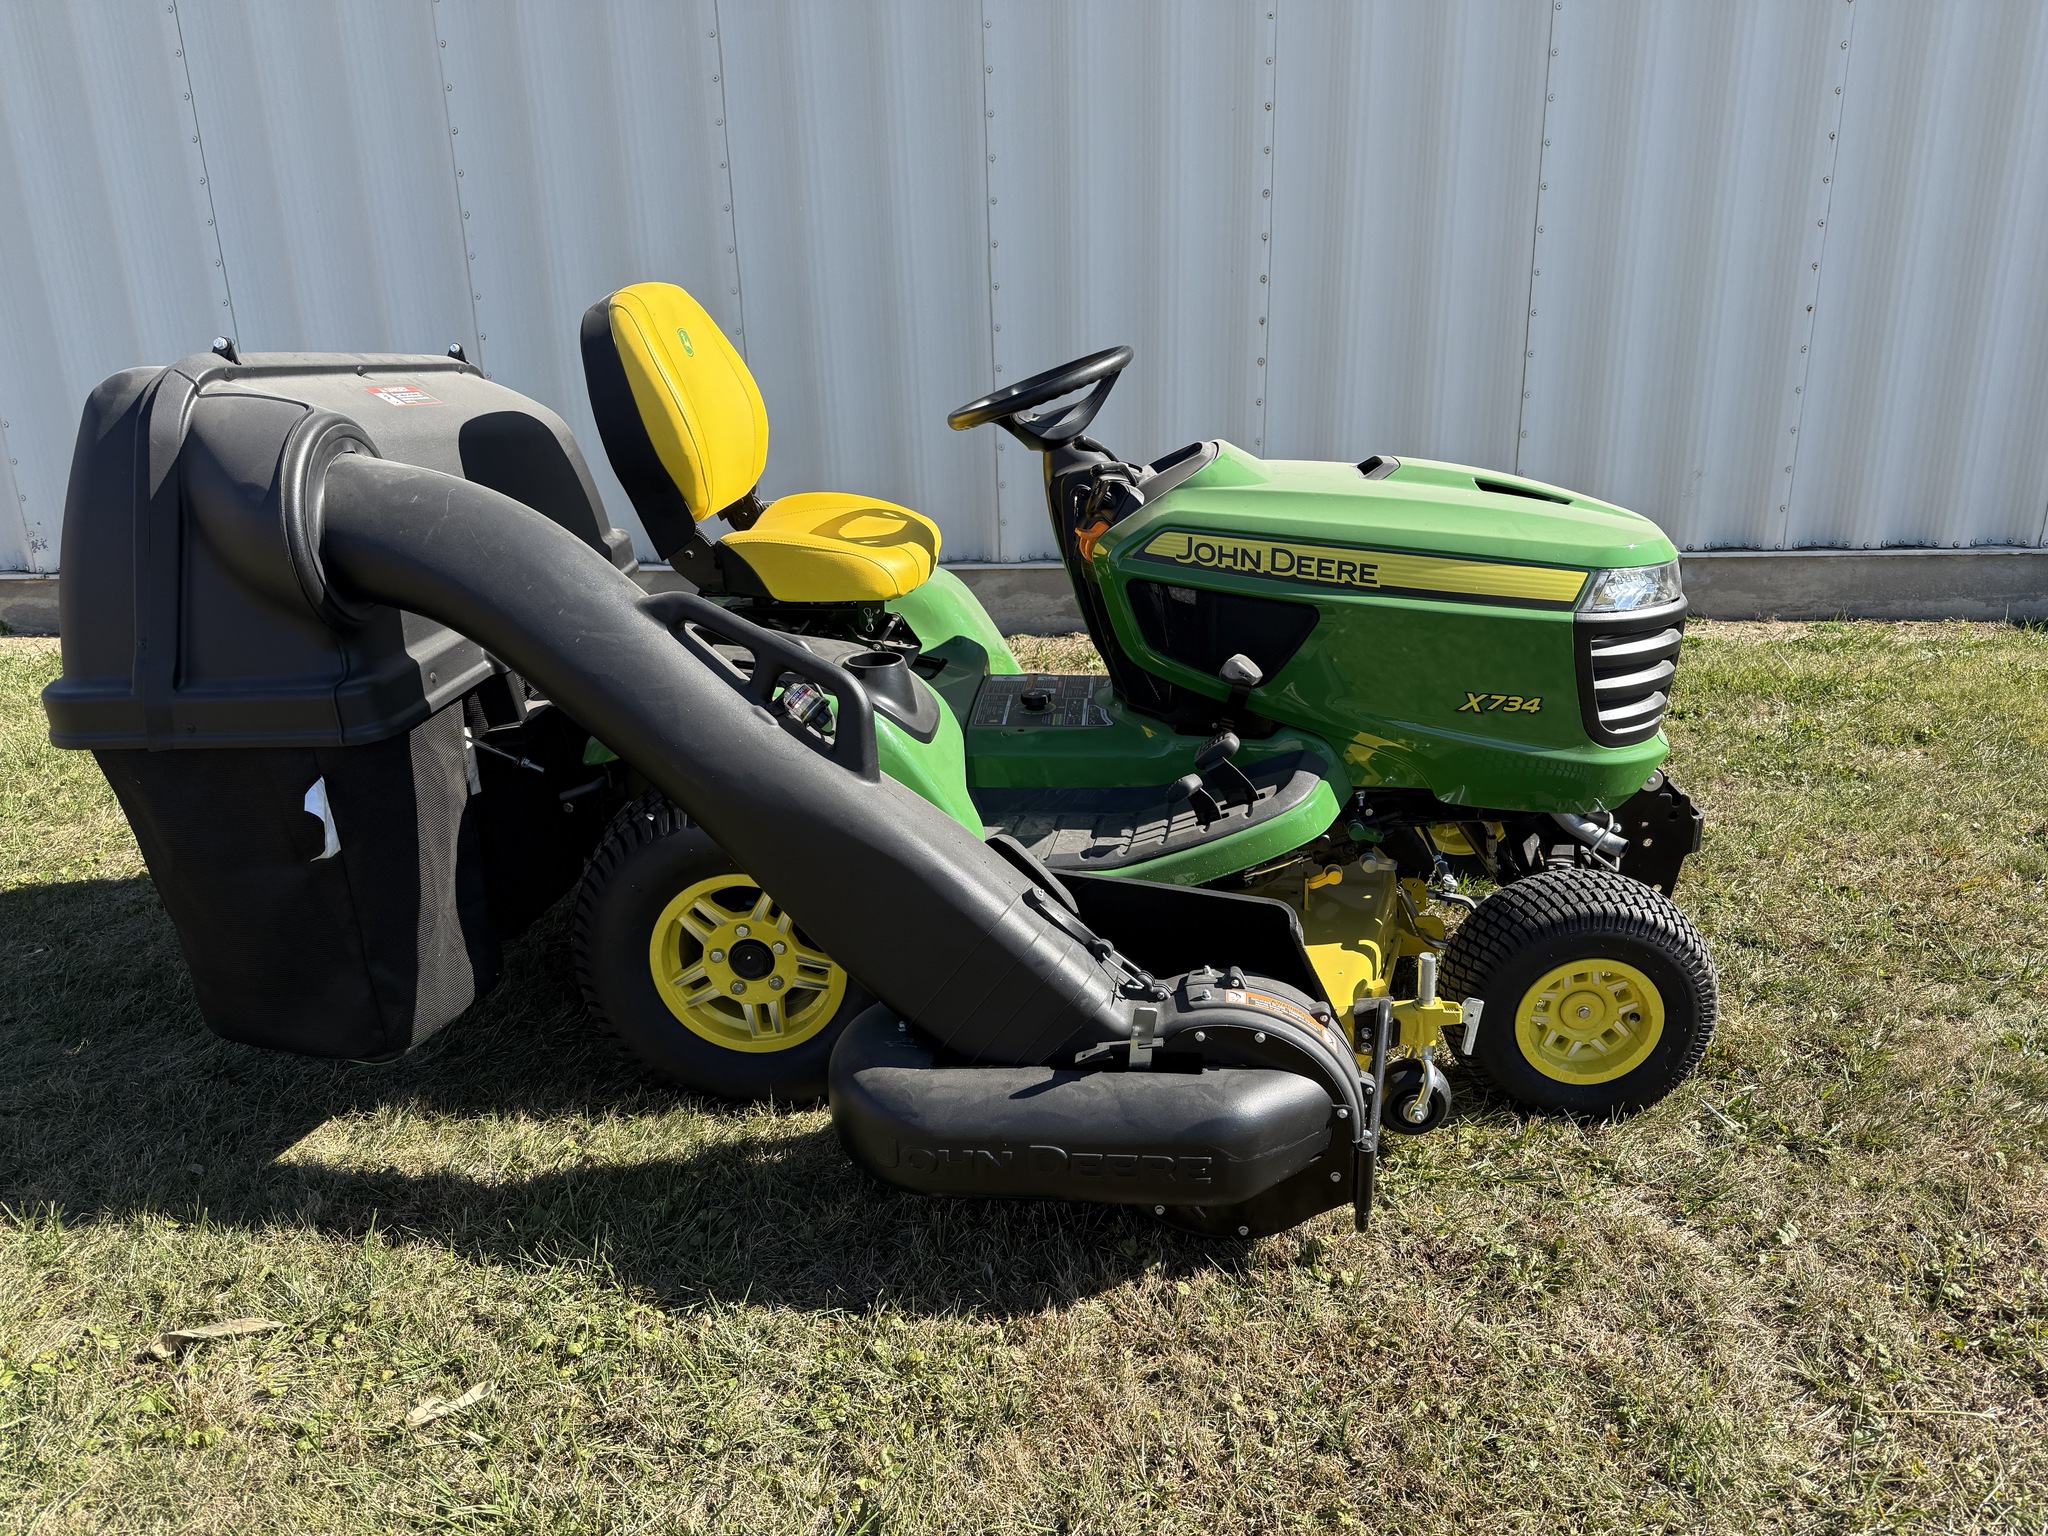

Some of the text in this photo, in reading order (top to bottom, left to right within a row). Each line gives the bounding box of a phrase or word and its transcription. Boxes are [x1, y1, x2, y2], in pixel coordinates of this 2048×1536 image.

[1176, 536, 1379, 585] JOHN DEERE
[1457, 692, 1542, 714] X734
[873, 1136, 1213, 1185] JOHN DEERE
